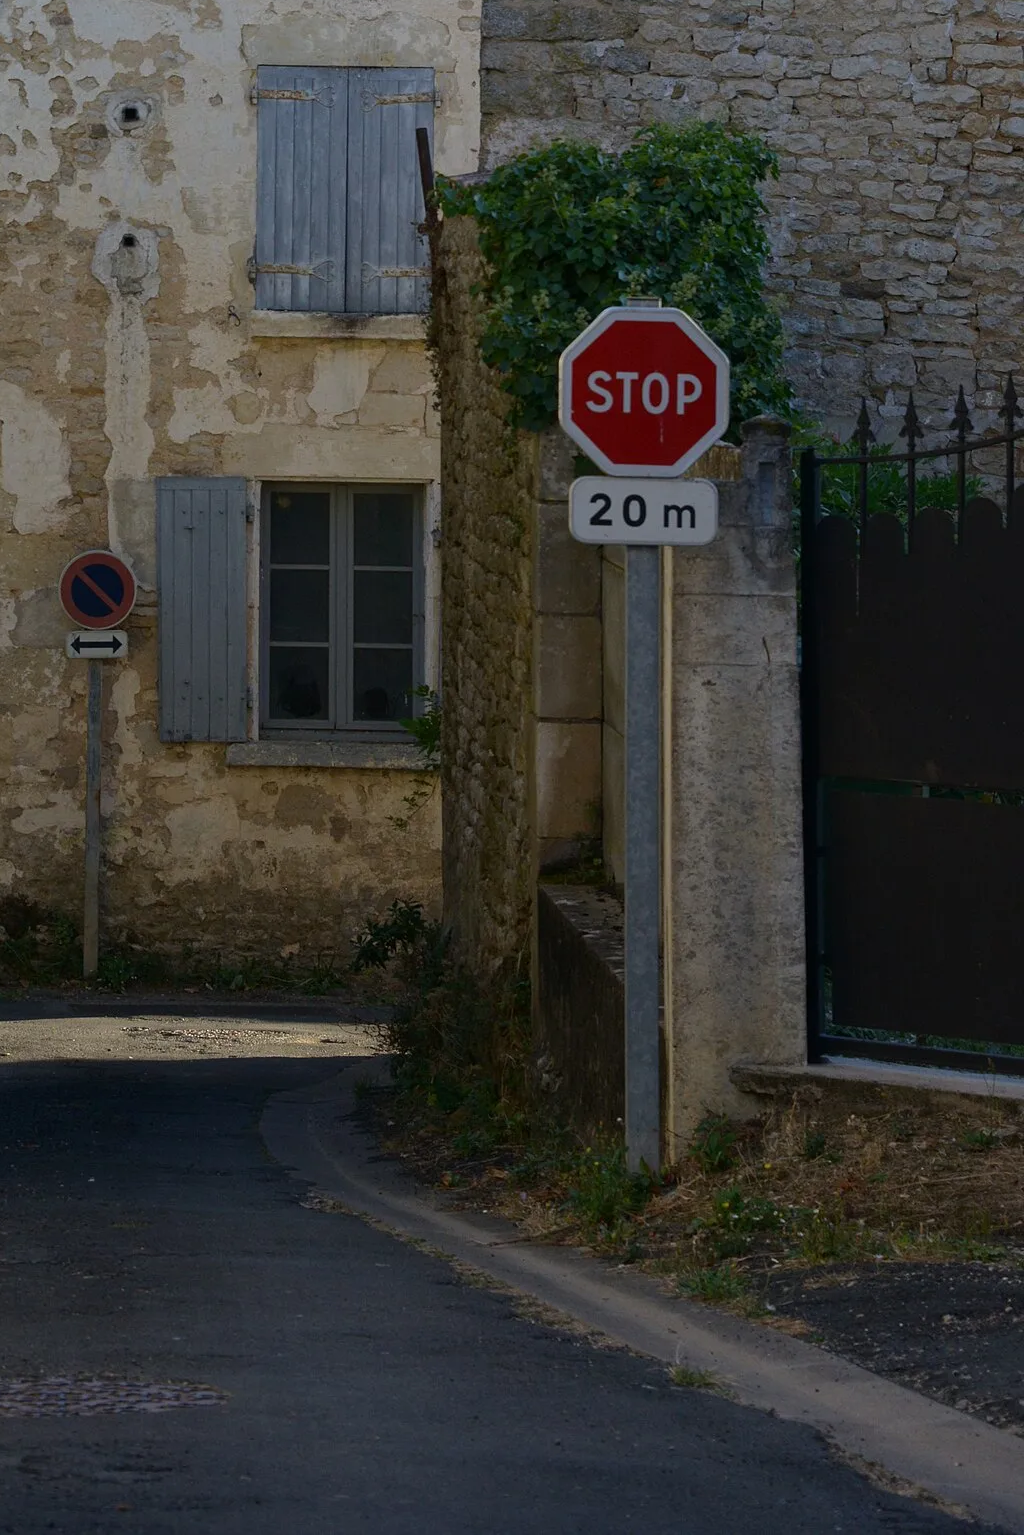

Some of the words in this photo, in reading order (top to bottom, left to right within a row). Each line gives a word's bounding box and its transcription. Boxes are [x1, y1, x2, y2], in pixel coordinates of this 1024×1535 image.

[585, 370, 703, 416] STOP
[589, 493, 647, 527] 20
[663, 503, 696, 529] m
